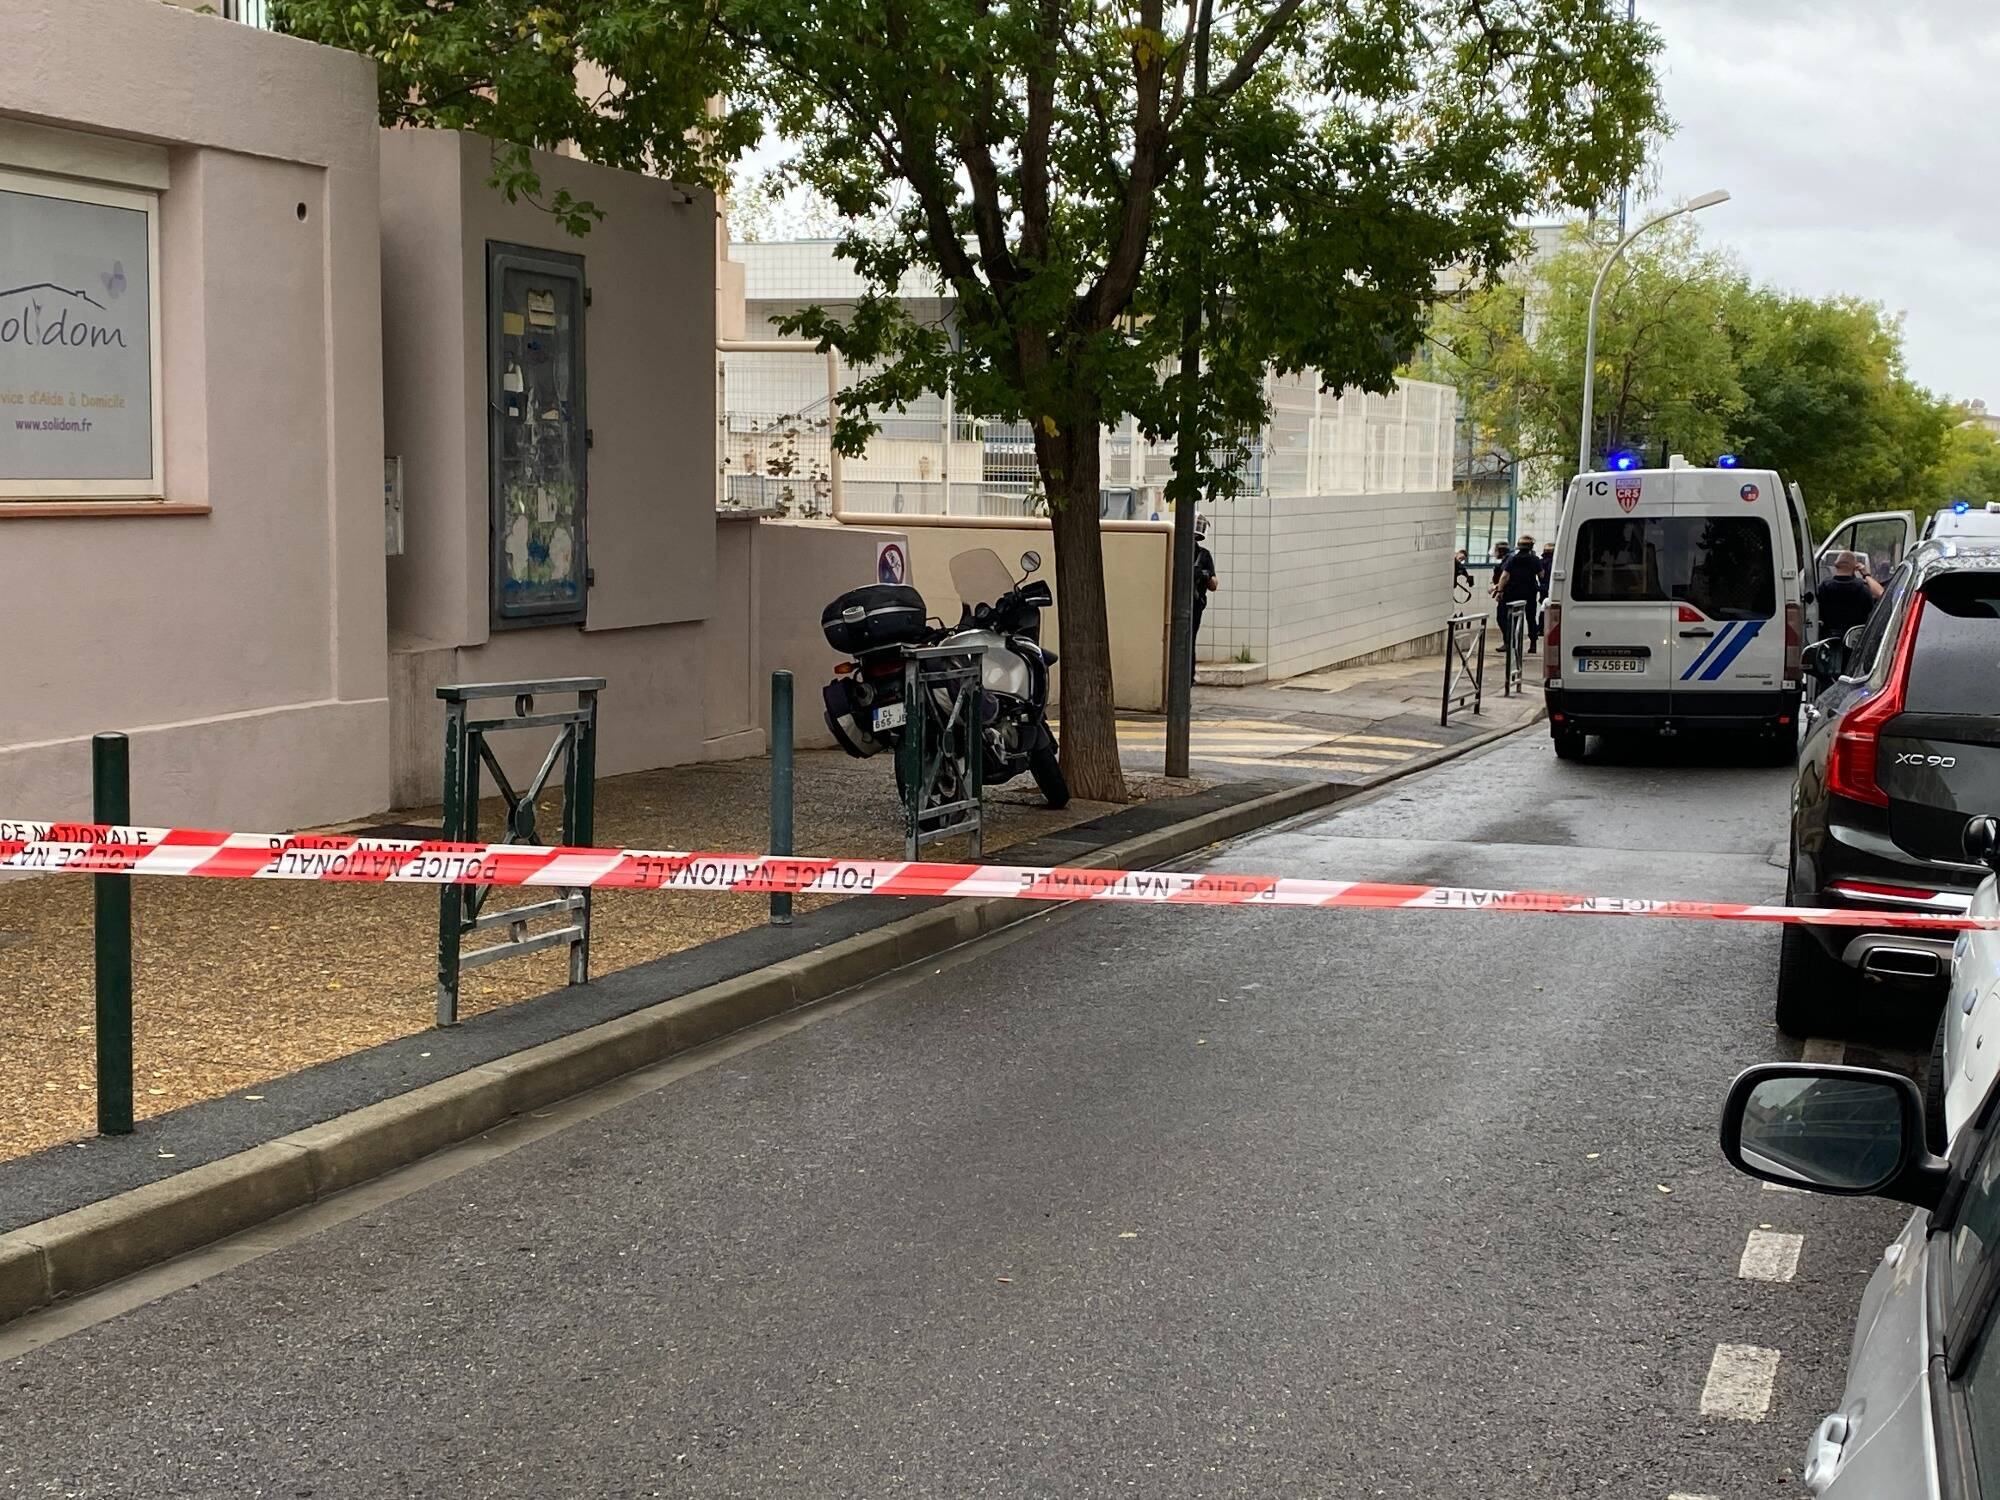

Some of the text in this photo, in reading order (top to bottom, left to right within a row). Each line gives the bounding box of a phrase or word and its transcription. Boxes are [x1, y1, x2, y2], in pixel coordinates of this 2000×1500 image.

[30, 391, 64, 406] d'Aide
[69, 391, 77, 407] à
[81, 393, 125, 408] Domicile
[16, 417, 92, 431] www.solidom.fr
[1585, 481, 1608, 496] 1C
[1617, 488, 1640, 498] CRS
[267, 852, 499, 880] POLICE NATIONALE
[634, 861, 876, 889] POLICE NATIONALE
[1020, 872, 1277, 900] POLICE NATIONALE
